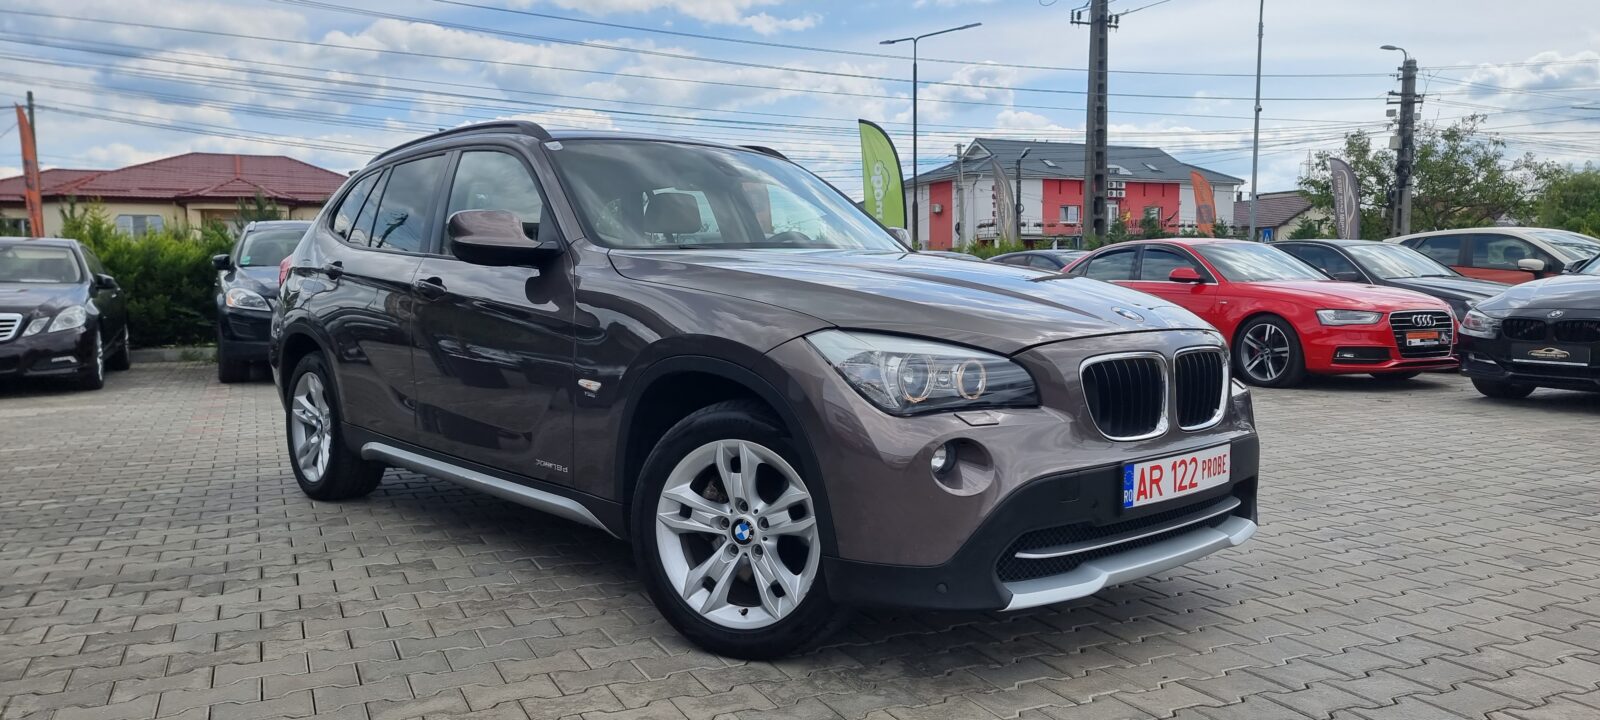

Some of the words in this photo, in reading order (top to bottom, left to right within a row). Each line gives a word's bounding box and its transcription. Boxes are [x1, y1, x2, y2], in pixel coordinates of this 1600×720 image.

[1136, 464, 1164, 501] AR
[1171, 457, 1198, 493] 122
[1201, 454, 1227, 480] PROBE
[1123, 489, 1133, 504] RO
